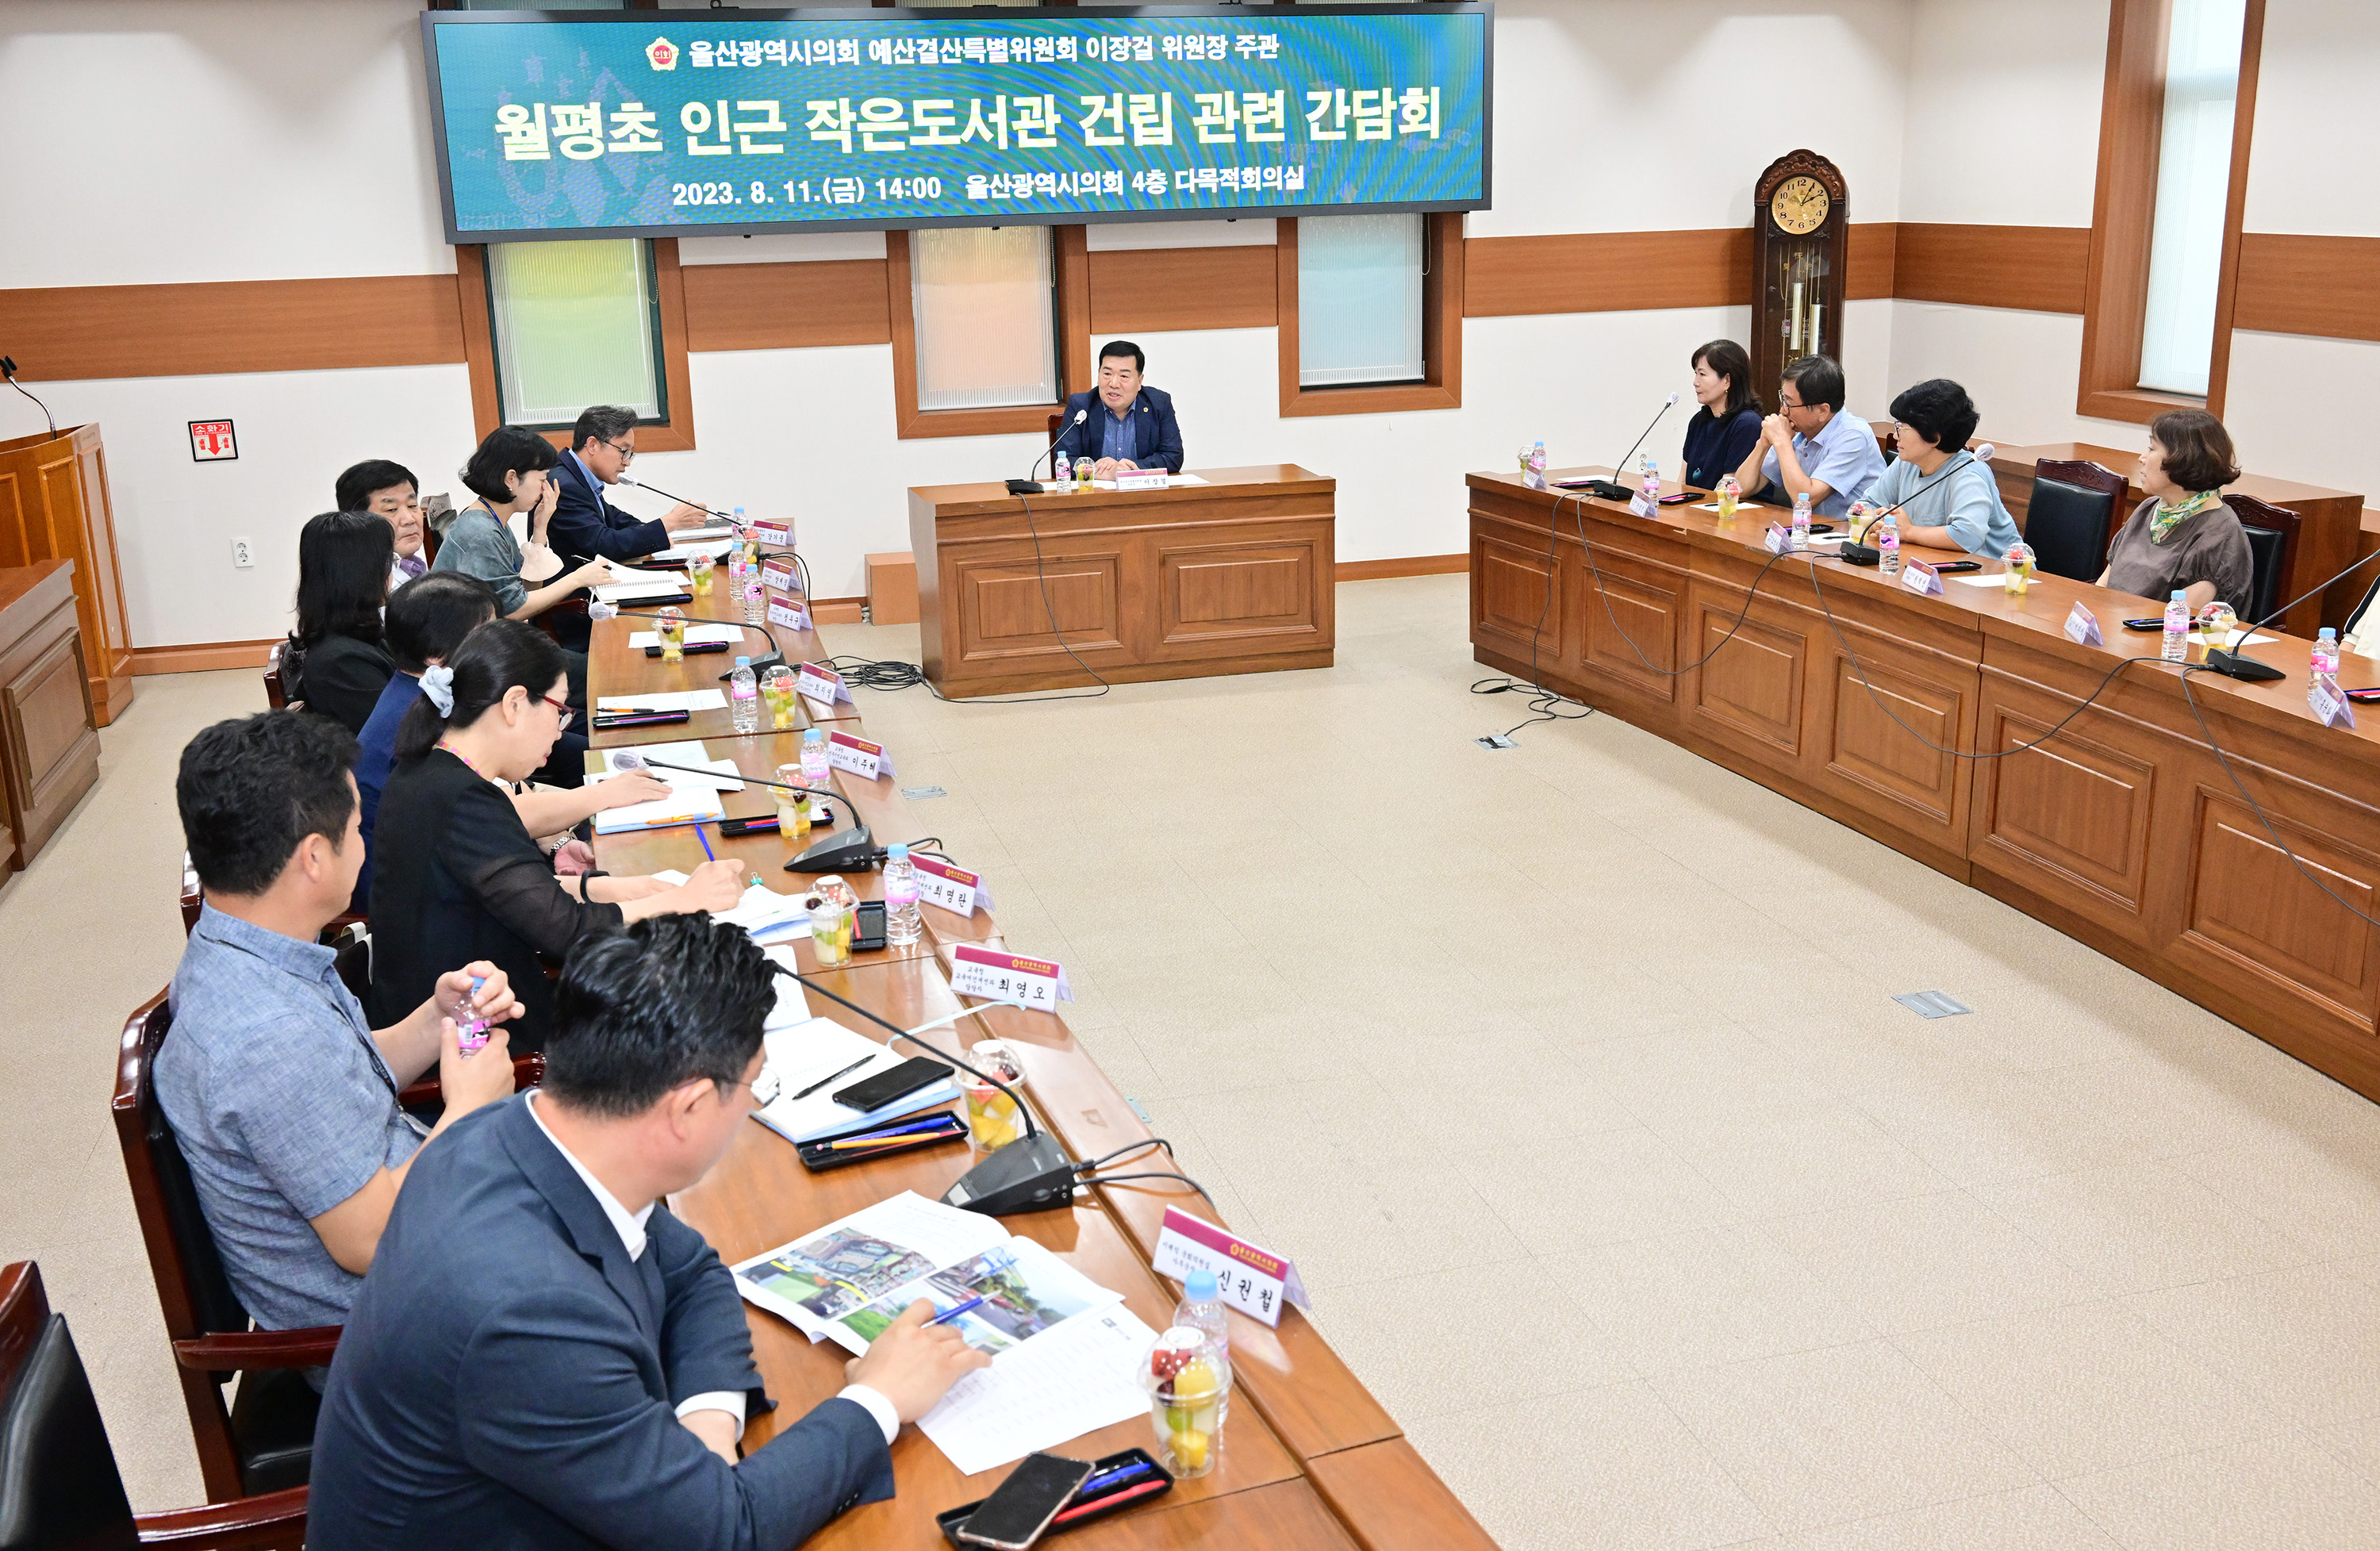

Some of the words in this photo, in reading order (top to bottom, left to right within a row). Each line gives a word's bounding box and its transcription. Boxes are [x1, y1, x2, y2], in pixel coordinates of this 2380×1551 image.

[689, 38, 860, 67] 울산광역시의회
[868, 36, 1077, 65] 예산결산특별위원회
[1086, 35, 1154, 62] 이장걸
[1161, 34, 1229, 61] 위원장
[1234, 33, 1280, 60] 주관
[494, 102, 663, 161] 월평초
[680, 99, 787, 155] 인근
[804, 94, 1061, 154] 작은도서관
[1078, 91, 1173, 147] 건립
[1192, 89, 1285, 144] 관련
[1305, 86, 1441, 141] 간담회
[672, 182, 742, 205] 2023.
[750, 181, 774, 204] 8.
[783, 176, 865, 204] 11.(금)
[875, 176, 942, 200] 14:00
[965, 170, 1123, 200] 울산광역시의회
[1131, 169, 1169, 195] 4층
[1175, 164, 1305, 194] 다목적회의실
[195, 424, 228, 433] 소화기
[933, 885, 967, 908] 최명란
[998, 978, 1045, 1000] 최영오
